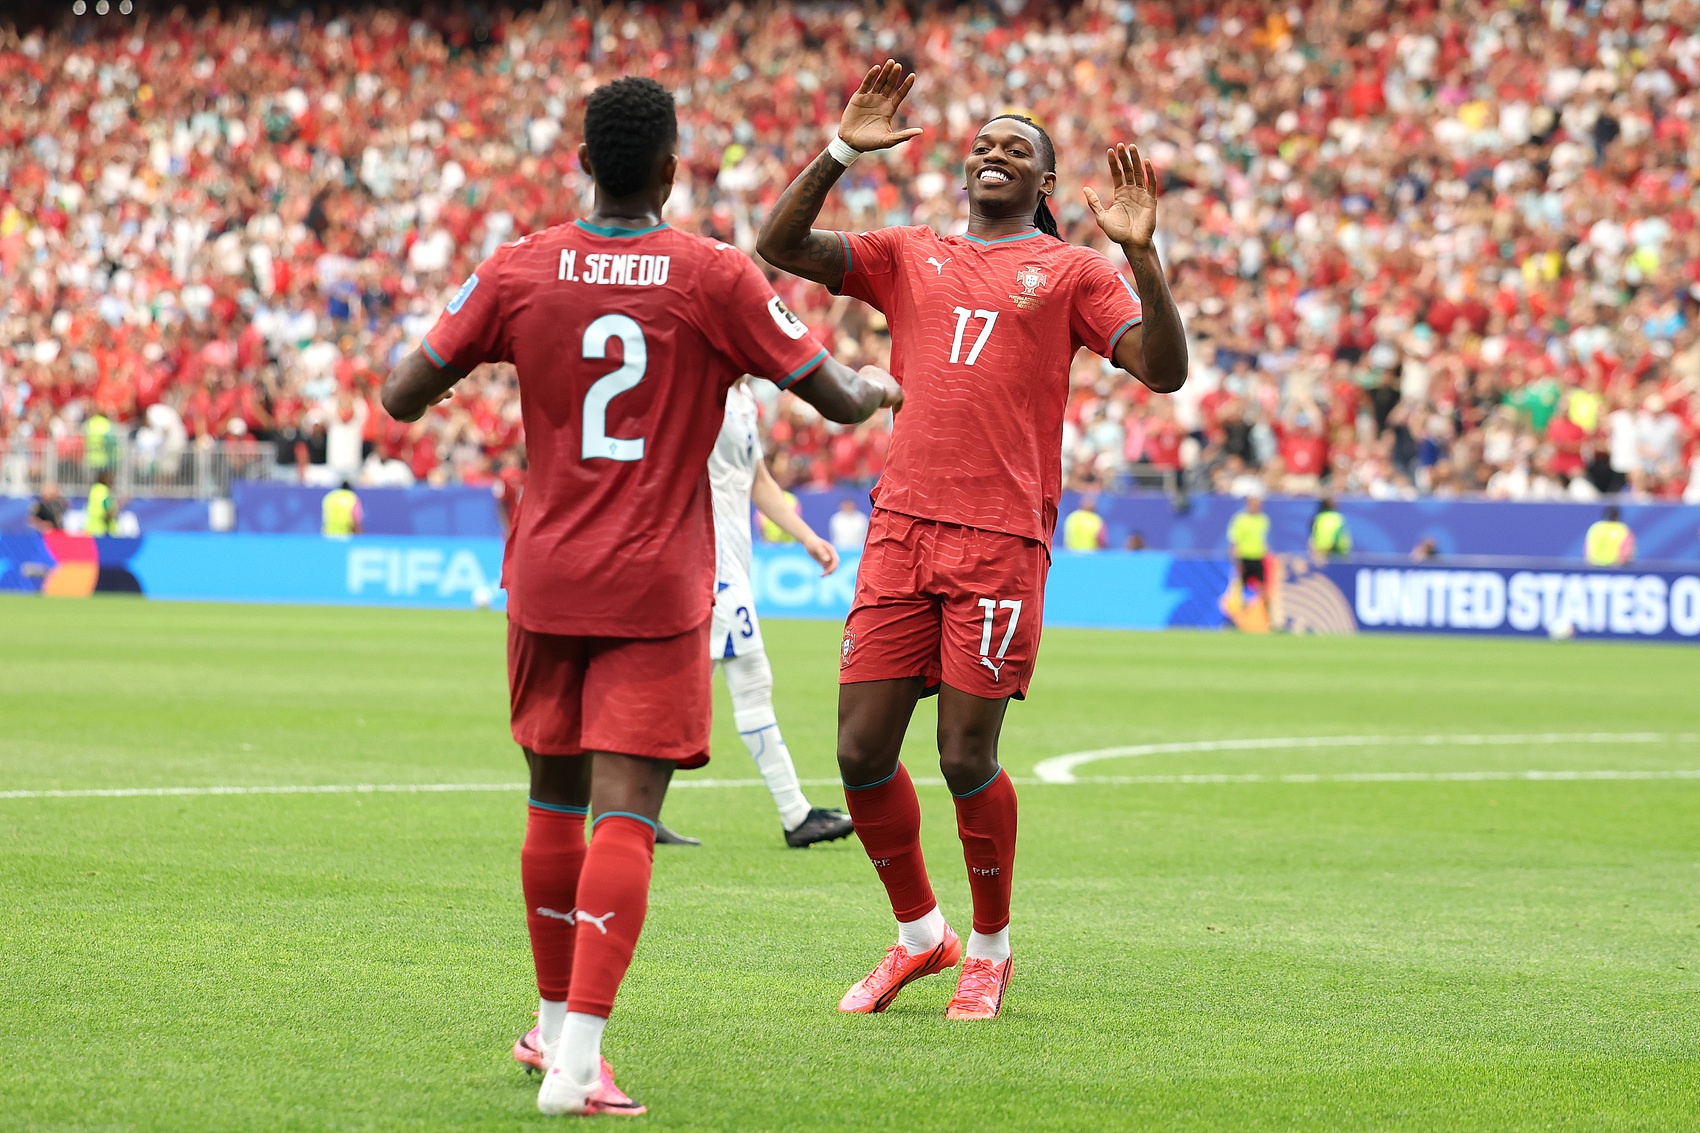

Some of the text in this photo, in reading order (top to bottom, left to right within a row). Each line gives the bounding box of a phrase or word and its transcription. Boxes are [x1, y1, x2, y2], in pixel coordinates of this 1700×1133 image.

[558, 248, 671, 286] N. SEMEDO
[949, 305, 1000, 367] 17
[581, 312, 648, 462] 2
[347, 548, 489, 597] FIFA
[1355, 567, 1506, 630] UNITED
[1507, 571, 1669, 635] STATES
[736, 606, 754, 639] 3
[978, 597, 1023, 659] 17
